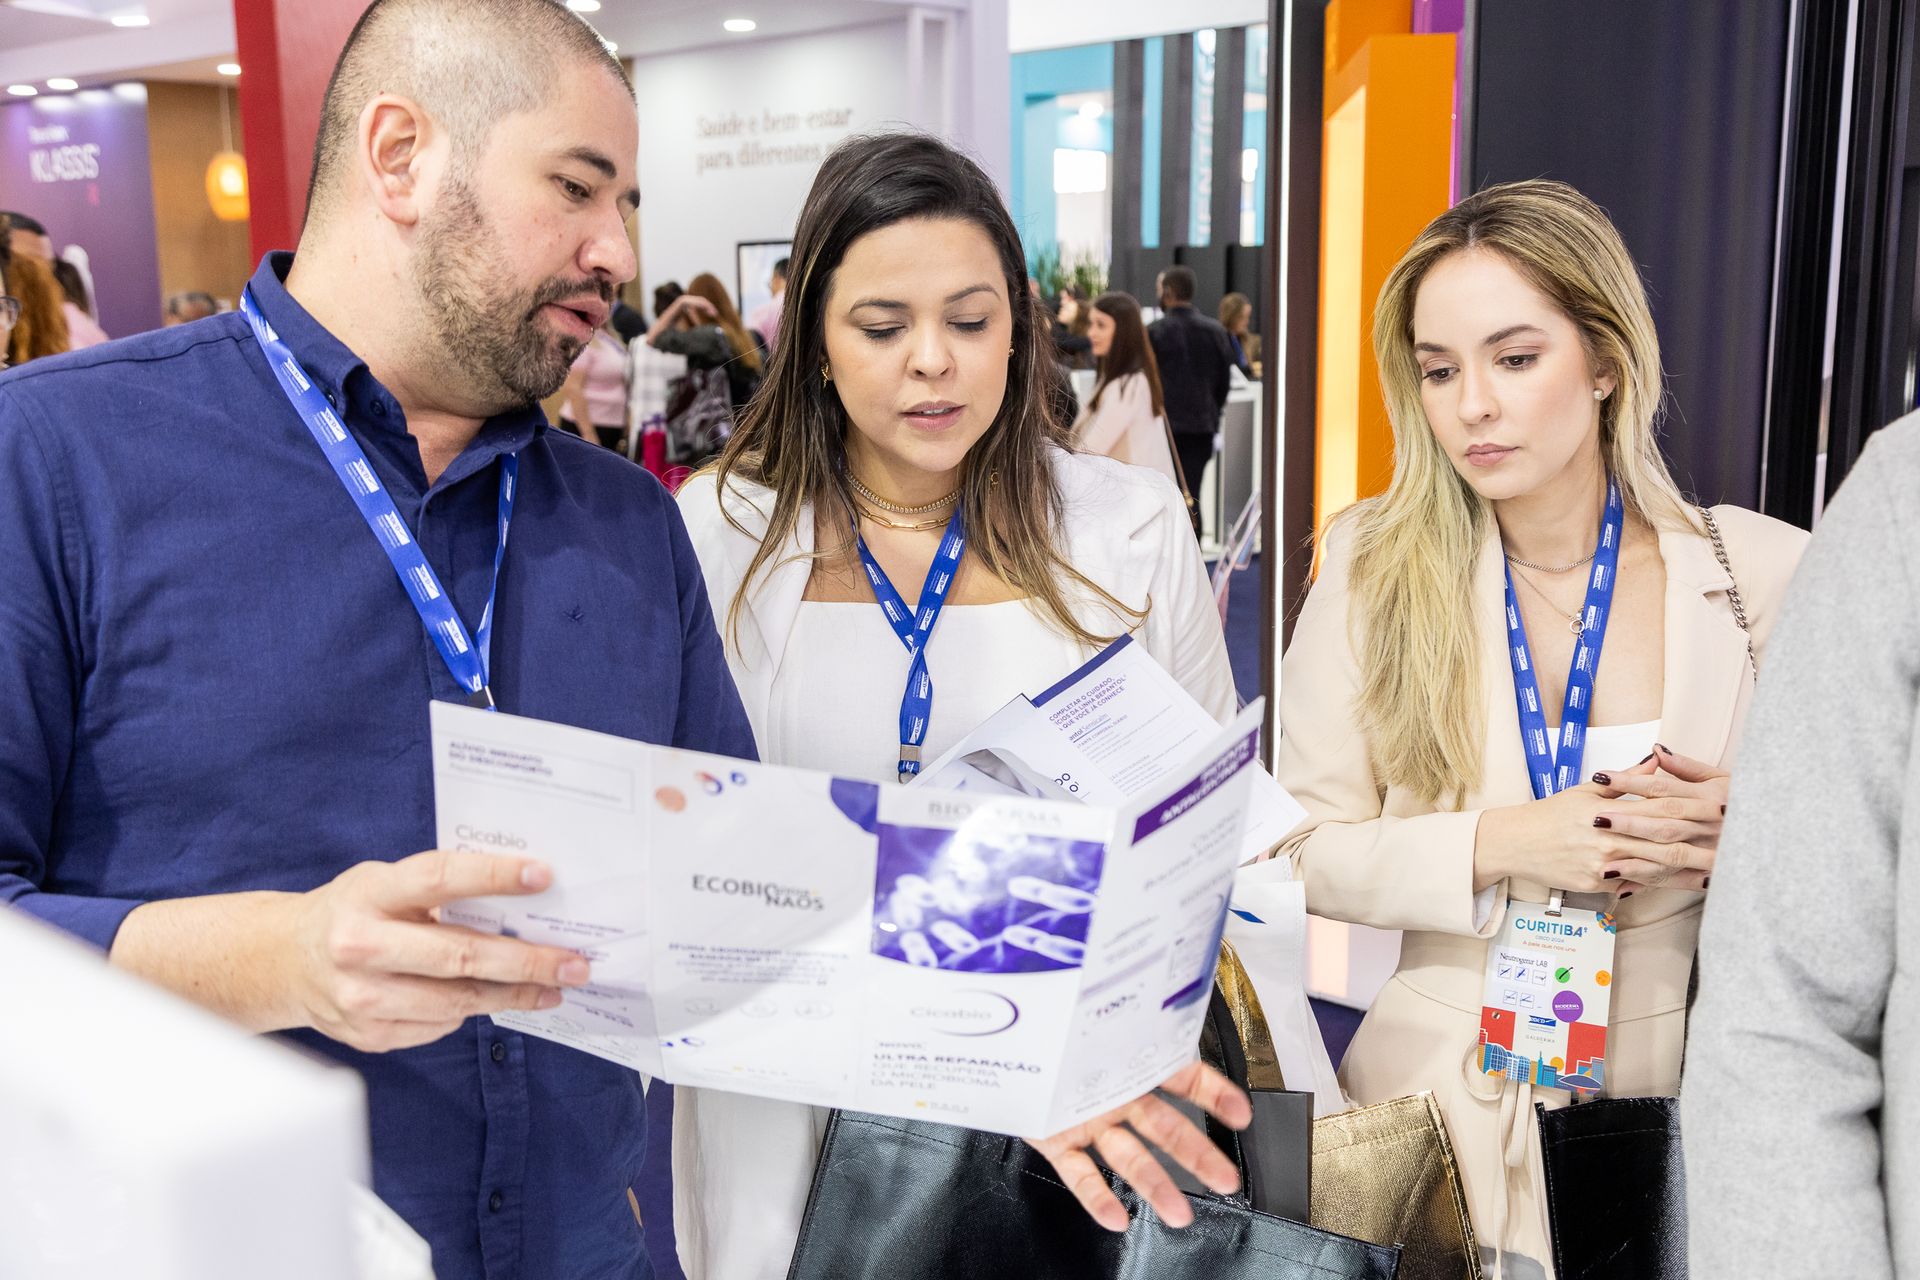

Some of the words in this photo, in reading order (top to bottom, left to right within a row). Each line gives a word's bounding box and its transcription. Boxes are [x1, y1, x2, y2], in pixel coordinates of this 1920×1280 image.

[1049, 698, 1081, 721] COMPLETAR
[1062, 718, 1075, 729] QUE
[1097, 686, 1125, 706] CONHECE
[1070, 708, 1079, 716] DA
[1079, 697, 1096, 710] LINHA
[455, 824, 527, 850] Cicabio
[1515, 918, 1583, 938] CURITIBA
[1500, 952, 1535, 966] Neutrogena
[1535, 959, 1549, 969] LAB
[910, 1006, 991, 1021] Cicabio
[874, 1052, 928, 1063] ULTRA
[934, 1055, 1042, 1075] REPARAÇÃO
[913, 1063, 999, 1079] RECUPERA
[891, 1071, 1001, 1089] MICROBIOMA
[899, 1080, 936, 1091] PELE
